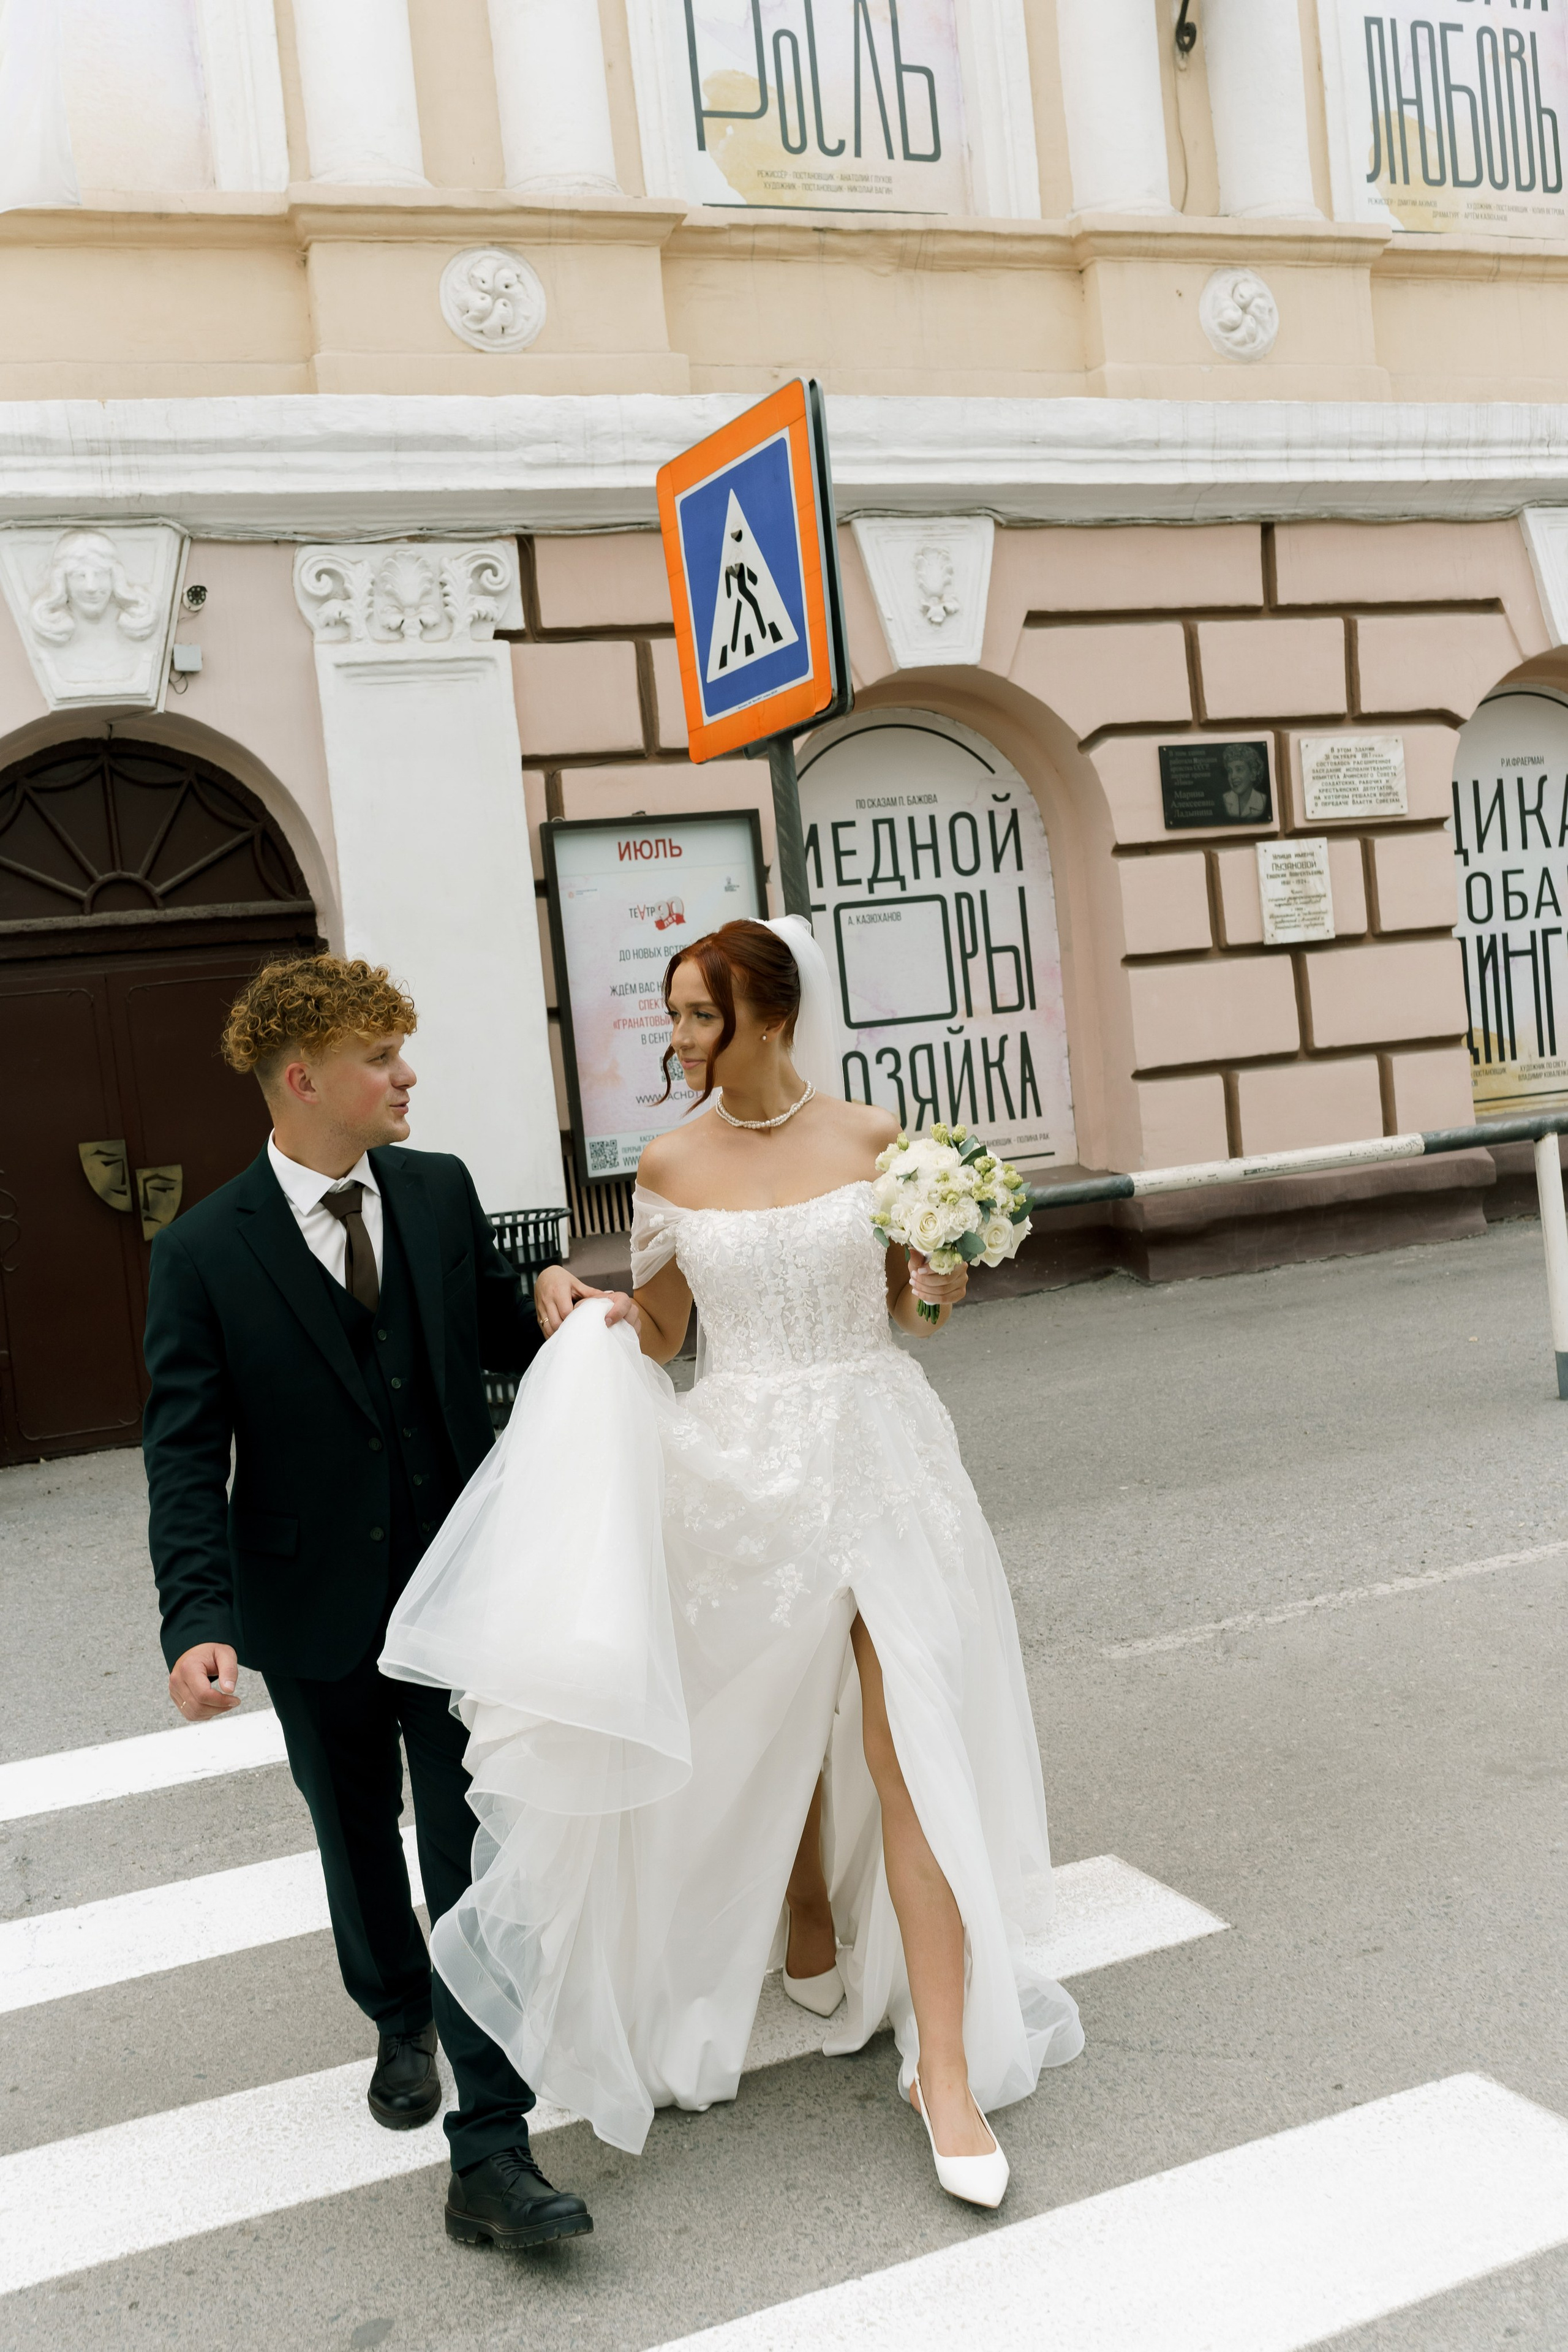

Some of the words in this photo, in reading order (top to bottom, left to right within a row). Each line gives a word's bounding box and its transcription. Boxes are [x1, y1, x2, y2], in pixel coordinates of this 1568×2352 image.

[1364, 16, 1563, 194] ЛЮБОВЬ
[793, 171, 834, 181] ПОСТАНОВЩИК
[764, 181, 796, 190] ХУДОЖНИК
[802, 183, 843, 193] ПОСТАНОВЩИК
[1496, 204, 1528, 214] ПОСТАНОВЩИК
[856, 799, 866, 810] ПО
[867, 796, 897, 809] СКАЗАМ
[907, 793, 938, 806] БАЖОВА
[617, 838, 683, 862] ИЮЛЬ
[856, 911, 902, 925] КАЗЮХАНОВ
[619, 949, 631, 962] ДО
[633, 947, 663, 960] НОВЫХ
[664, 944, 688, 957] ВСТР
[609, 982, 638, 997] ЖДЁМ
[639, 981, 656, 994] ВАС
[638, 998, 665, 1011] СПЕКТ
[641, 1033, 647, 1045] В
[1473, 1068, 1507, 1078] ПОСТАНОВЩИК
[1520, 1063, 1545, 1072] ХУДОЖНИК
[842, 1025, 1042, 1132] ОЗЯЙКА
[1518, 1072, 1543, 1082] ВЛАДИМИР
[1017, 1134, 1038, 1144] ПОЛИНА
